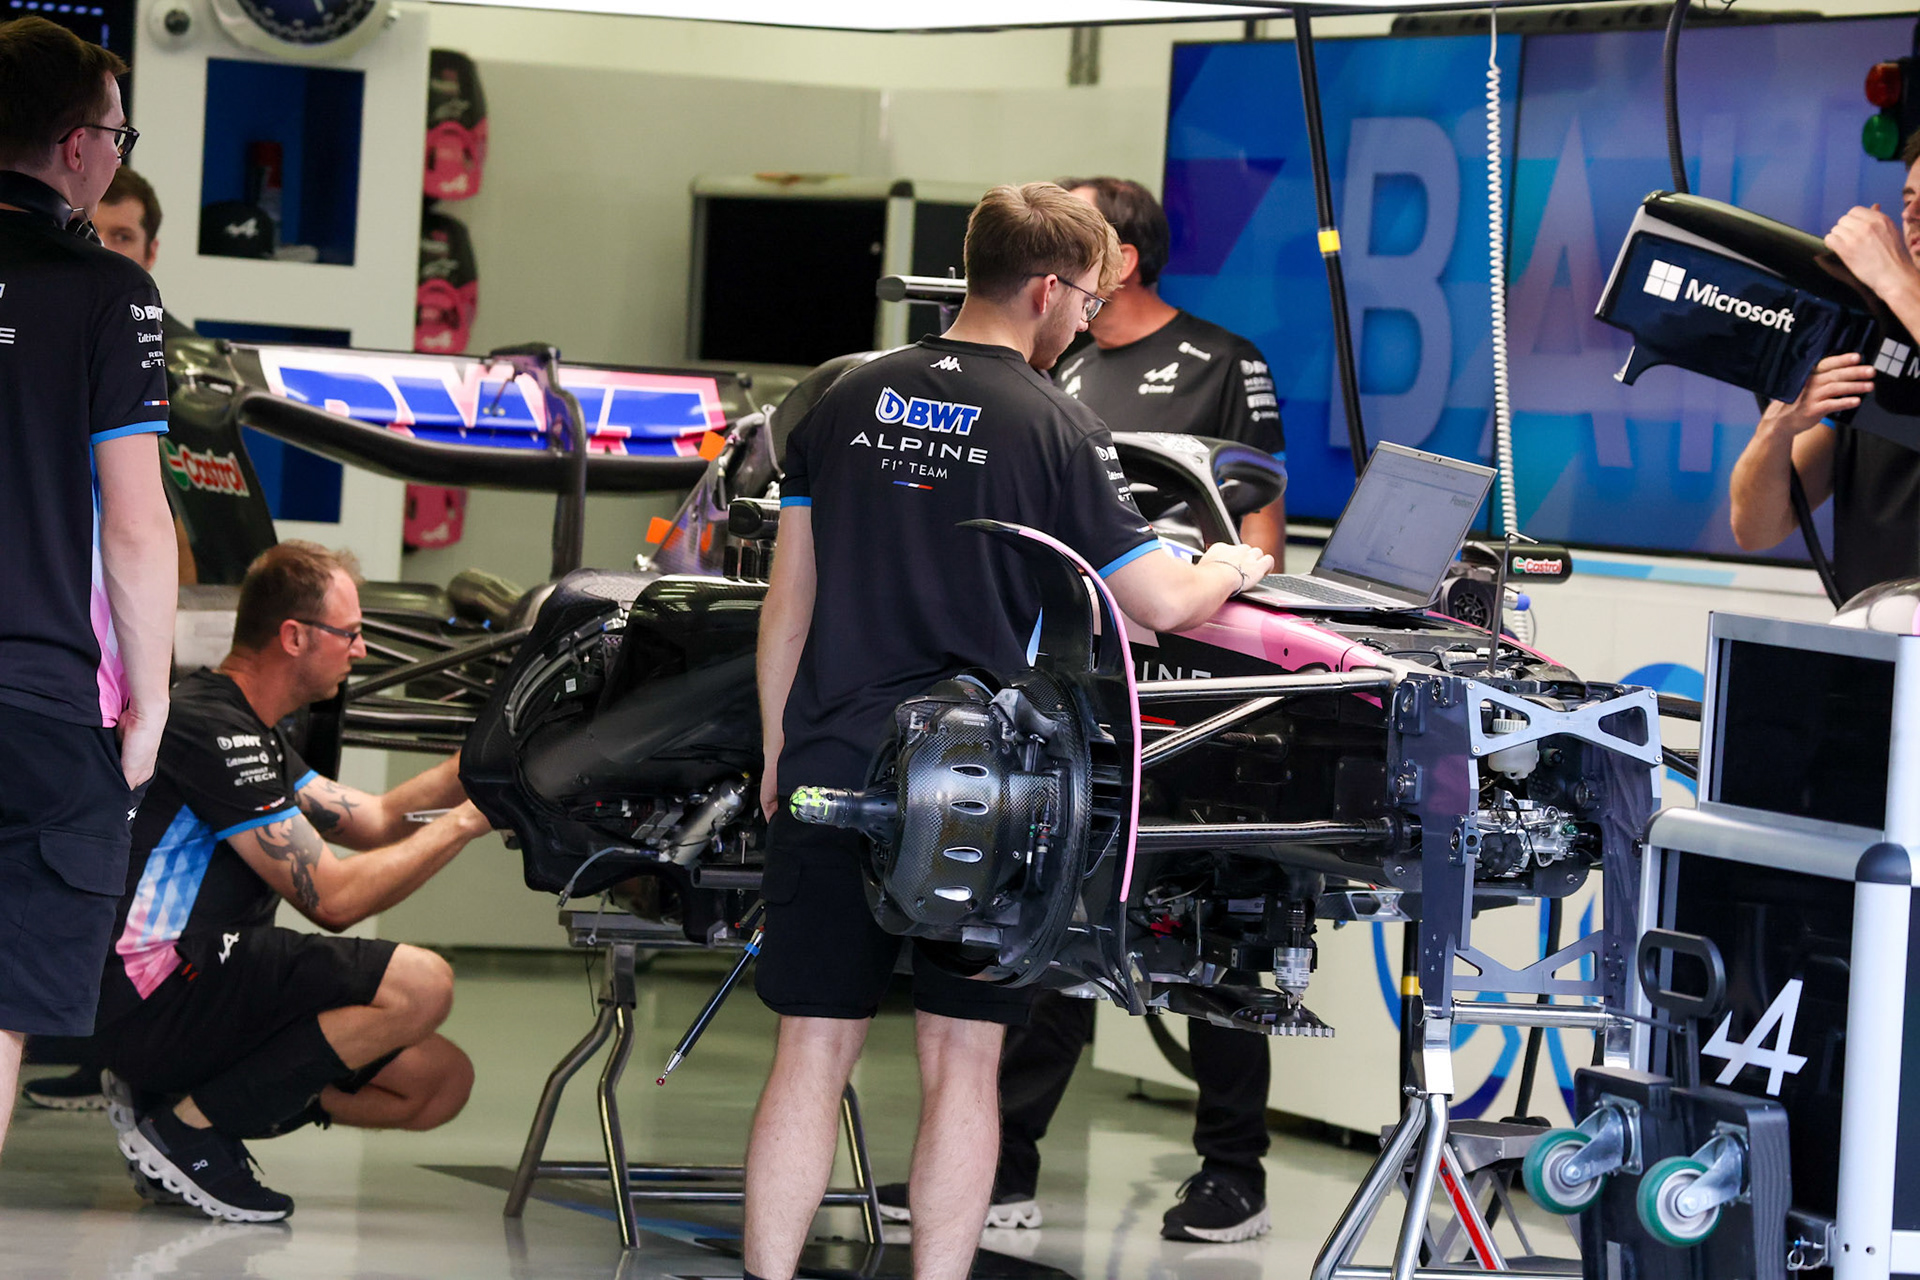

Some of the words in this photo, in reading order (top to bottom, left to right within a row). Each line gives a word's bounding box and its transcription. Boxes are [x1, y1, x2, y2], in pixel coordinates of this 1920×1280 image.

[1685, 278, 1795, 333] Microsoft
[902, 396, 982, 436] BWT
[849, 431, 988, 465] ALPINE
[179, 444, 250, 497] Castrol
[908, 462, 948, 480] TEAM
[1524, 558, 1562, 575] Castrol
